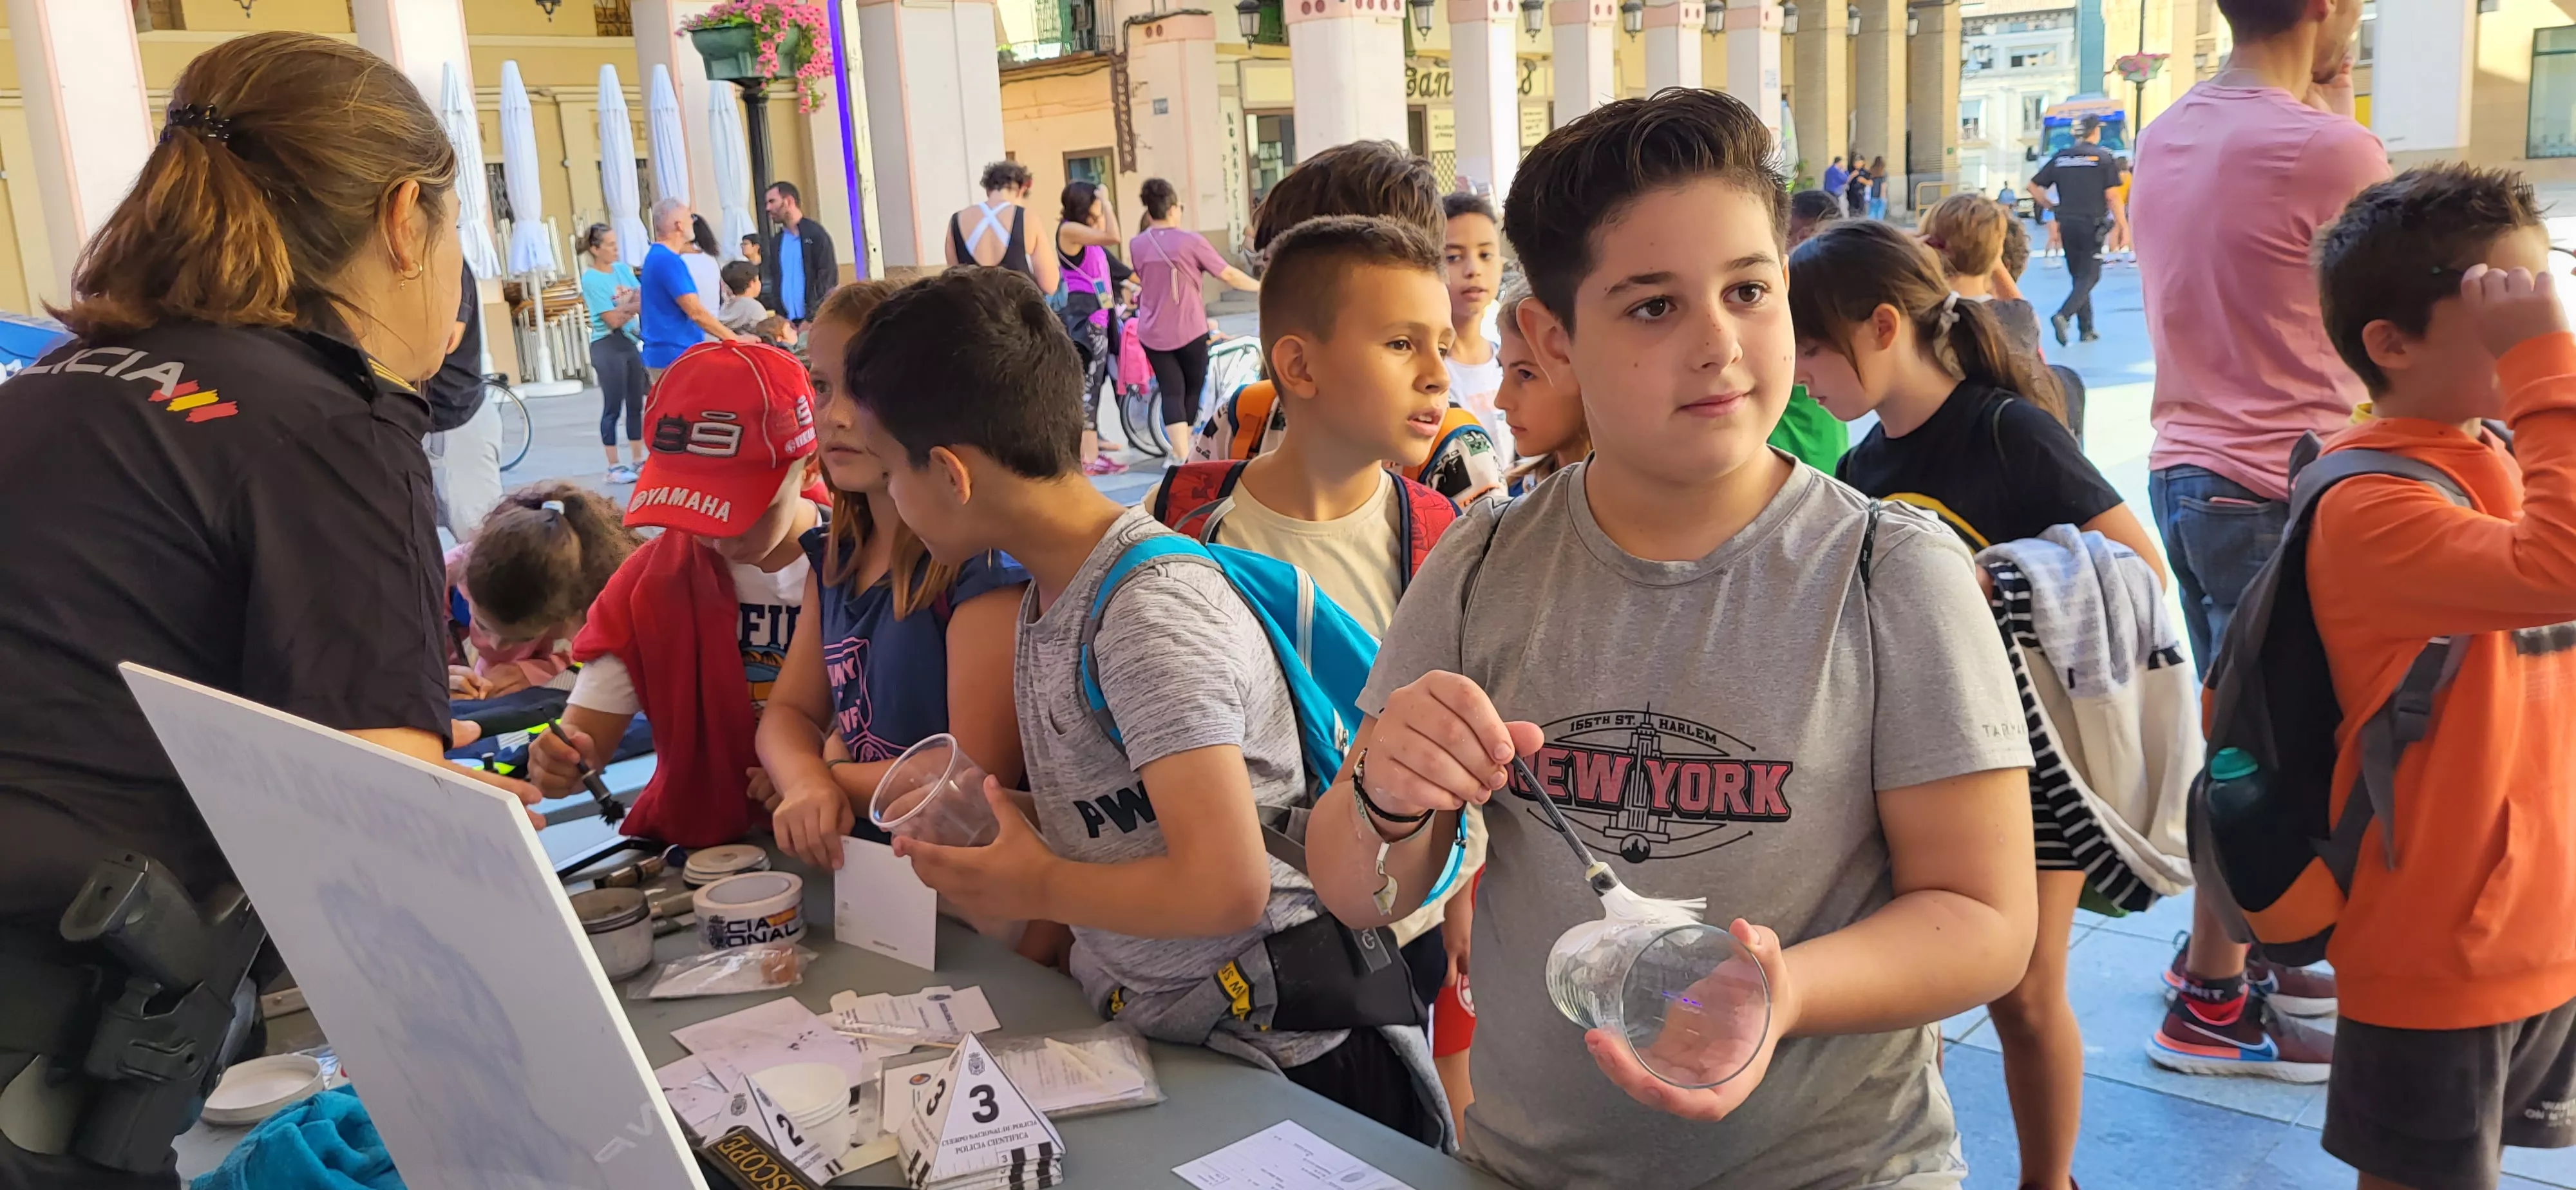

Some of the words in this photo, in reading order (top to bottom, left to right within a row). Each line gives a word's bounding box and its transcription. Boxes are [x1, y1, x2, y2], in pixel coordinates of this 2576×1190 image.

[646, 486, 730, 522] YAMAHA
[1658, 719, 1718, 745] HARLEM
[1643, 760, 1794, 822] YORK
[926, 1079, 946, 1116] 3
[969, 1084, 999, 1123] 3
[776, 1113, 804, 1147] 2
[942, 1135, 969, 1147] CUERPO
[969, 1128, 1002, 1140] NACIONAL
[1012, 1119, 1037, 1130] POLICIA
[955, 1143, 986, 1155] POLICIA
[987, 1131, 1029, 1147] CIENTIFICA
[1001, 1155, 1009, 1163] 3
